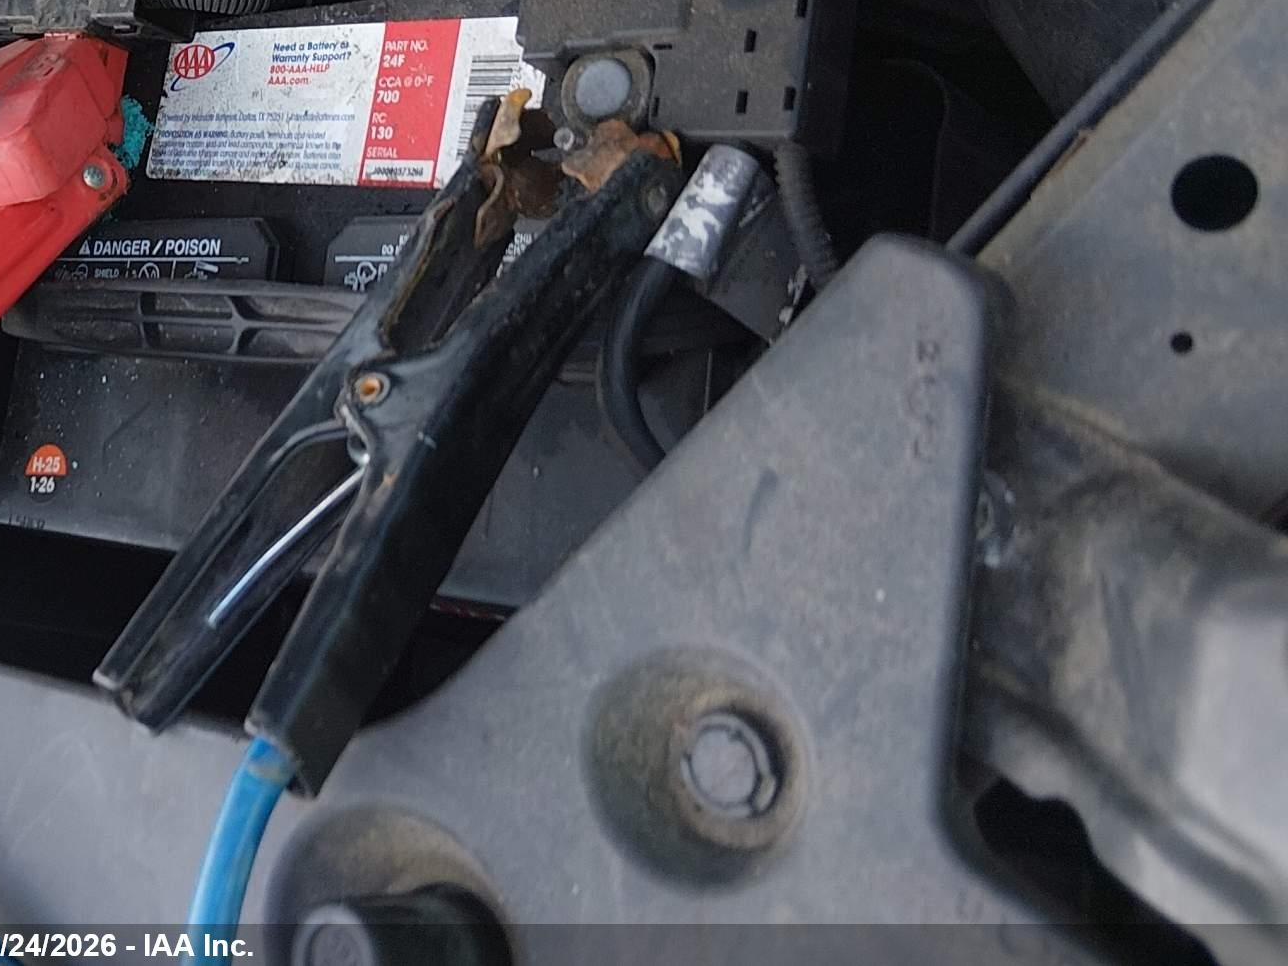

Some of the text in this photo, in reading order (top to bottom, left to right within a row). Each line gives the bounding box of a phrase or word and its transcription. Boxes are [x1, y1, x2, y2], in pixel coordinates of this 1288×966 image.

[273, 42, 297, 52] Need
[298, 43, 305, 51] a
[307, 41, 337, 52] Battery
[384, 40, 428, 52] PART NO.
[176, 46, 212, 77] AAA
[272, 51, 352, 64] Warranty Support?
[383, 54, 405, 68] 24F
[270, 63, 330, 74] 800-AAA-HELP
[267, 75, 309, 85] AAA.com
[379, 76, 402, 87] CCA
[376, 90, 400, 103] 700
[372, 112, 387, 123] RC
[370, 126, 393, 139] 130
[367, 146, 398, 158] SERIAL
[93, 238, 221, 256] DANGER / POISON
[94, 268, 119, 278] SHIELD
[32, 456, 61, 473] H-25
[30, 476, 55, 493] 1-26
